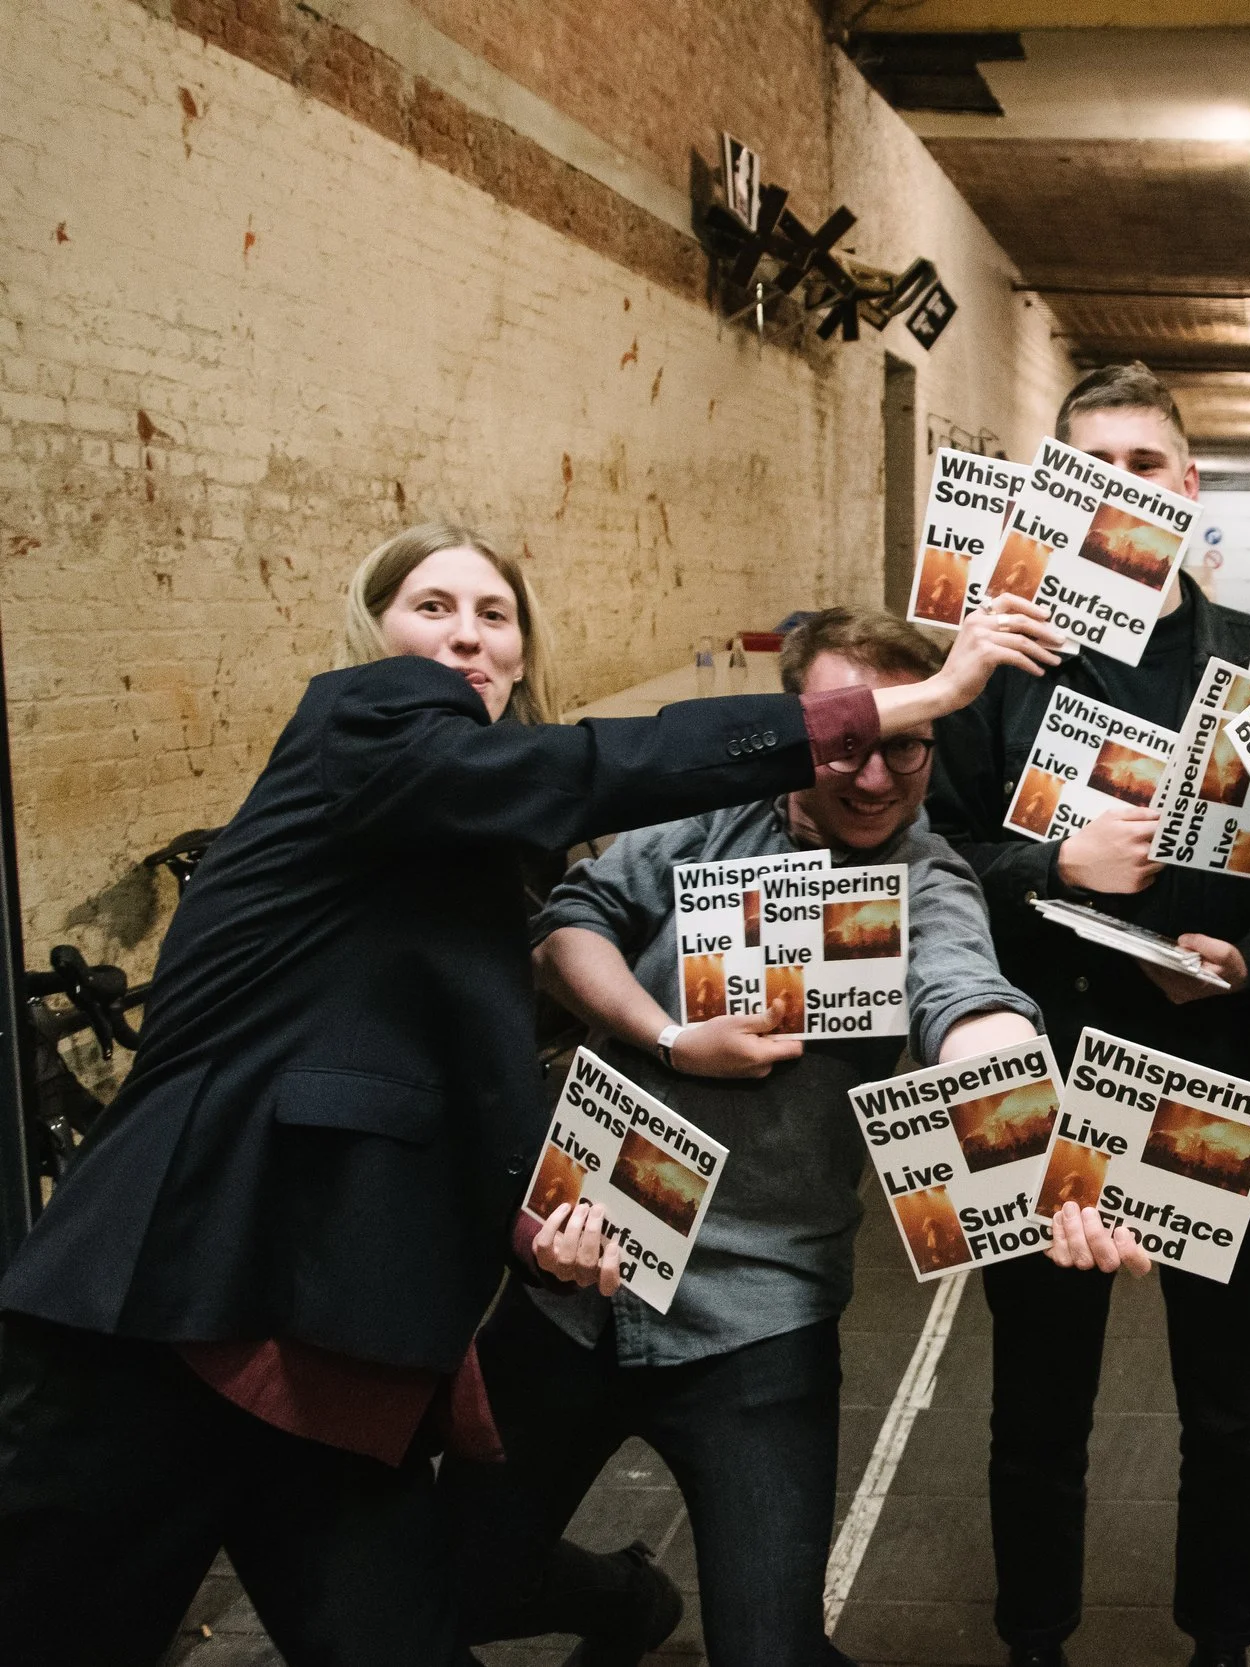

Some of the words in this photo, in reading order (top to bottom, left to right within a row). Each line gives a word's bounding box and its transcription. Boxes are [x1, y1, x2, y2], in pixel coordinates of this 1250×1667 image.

[941, 456, 1026, 497] Whisp
[1030, 469, 1097, 513] Sons
[1042, 444, 1193, 532] Whispering
[935, 481, 1005, 514] Sons
[926, 524, 984, 555] Live
[1012, 509, 1069, 549] Live
[1040, 574, 1146, 635] Surface
[1046, 713, 1102, 749] Sons
[1031, 748, 1078, 780] Live
[1156, 713, 1217, 858] Whispering
[1176, 801, 1208, 862] Sons
[1209, 817, 1239, 869] Live
[680, 892, 740, 913] Sons
[764, 872, 900, 900] Whispering
[764, 903, 820, 922] Sons
[682, 933, 732, 954] Live
[765, 944, 812, 965] Live
[806, 986, 902, 1009] Surface
[807, 1011, 872, 1033] Flood
[854, 1049, 1047, 1119] Whispering
[1073, 1065, 1156, 1112] Sons
[566, 1081, 626, 1138] Sons
[575, 1056, 717, 1176] Whispering
[867, 1108, 950, 1146] Sons
[551, 1122, 601, 1172] Live
[1058, 1113, 1128, 1155] Live
[884, 1162, 953, 1196] Live
[959, 1192, 1033, 1232] Surf
[1100, 1185, 1234, 1248] Surface
